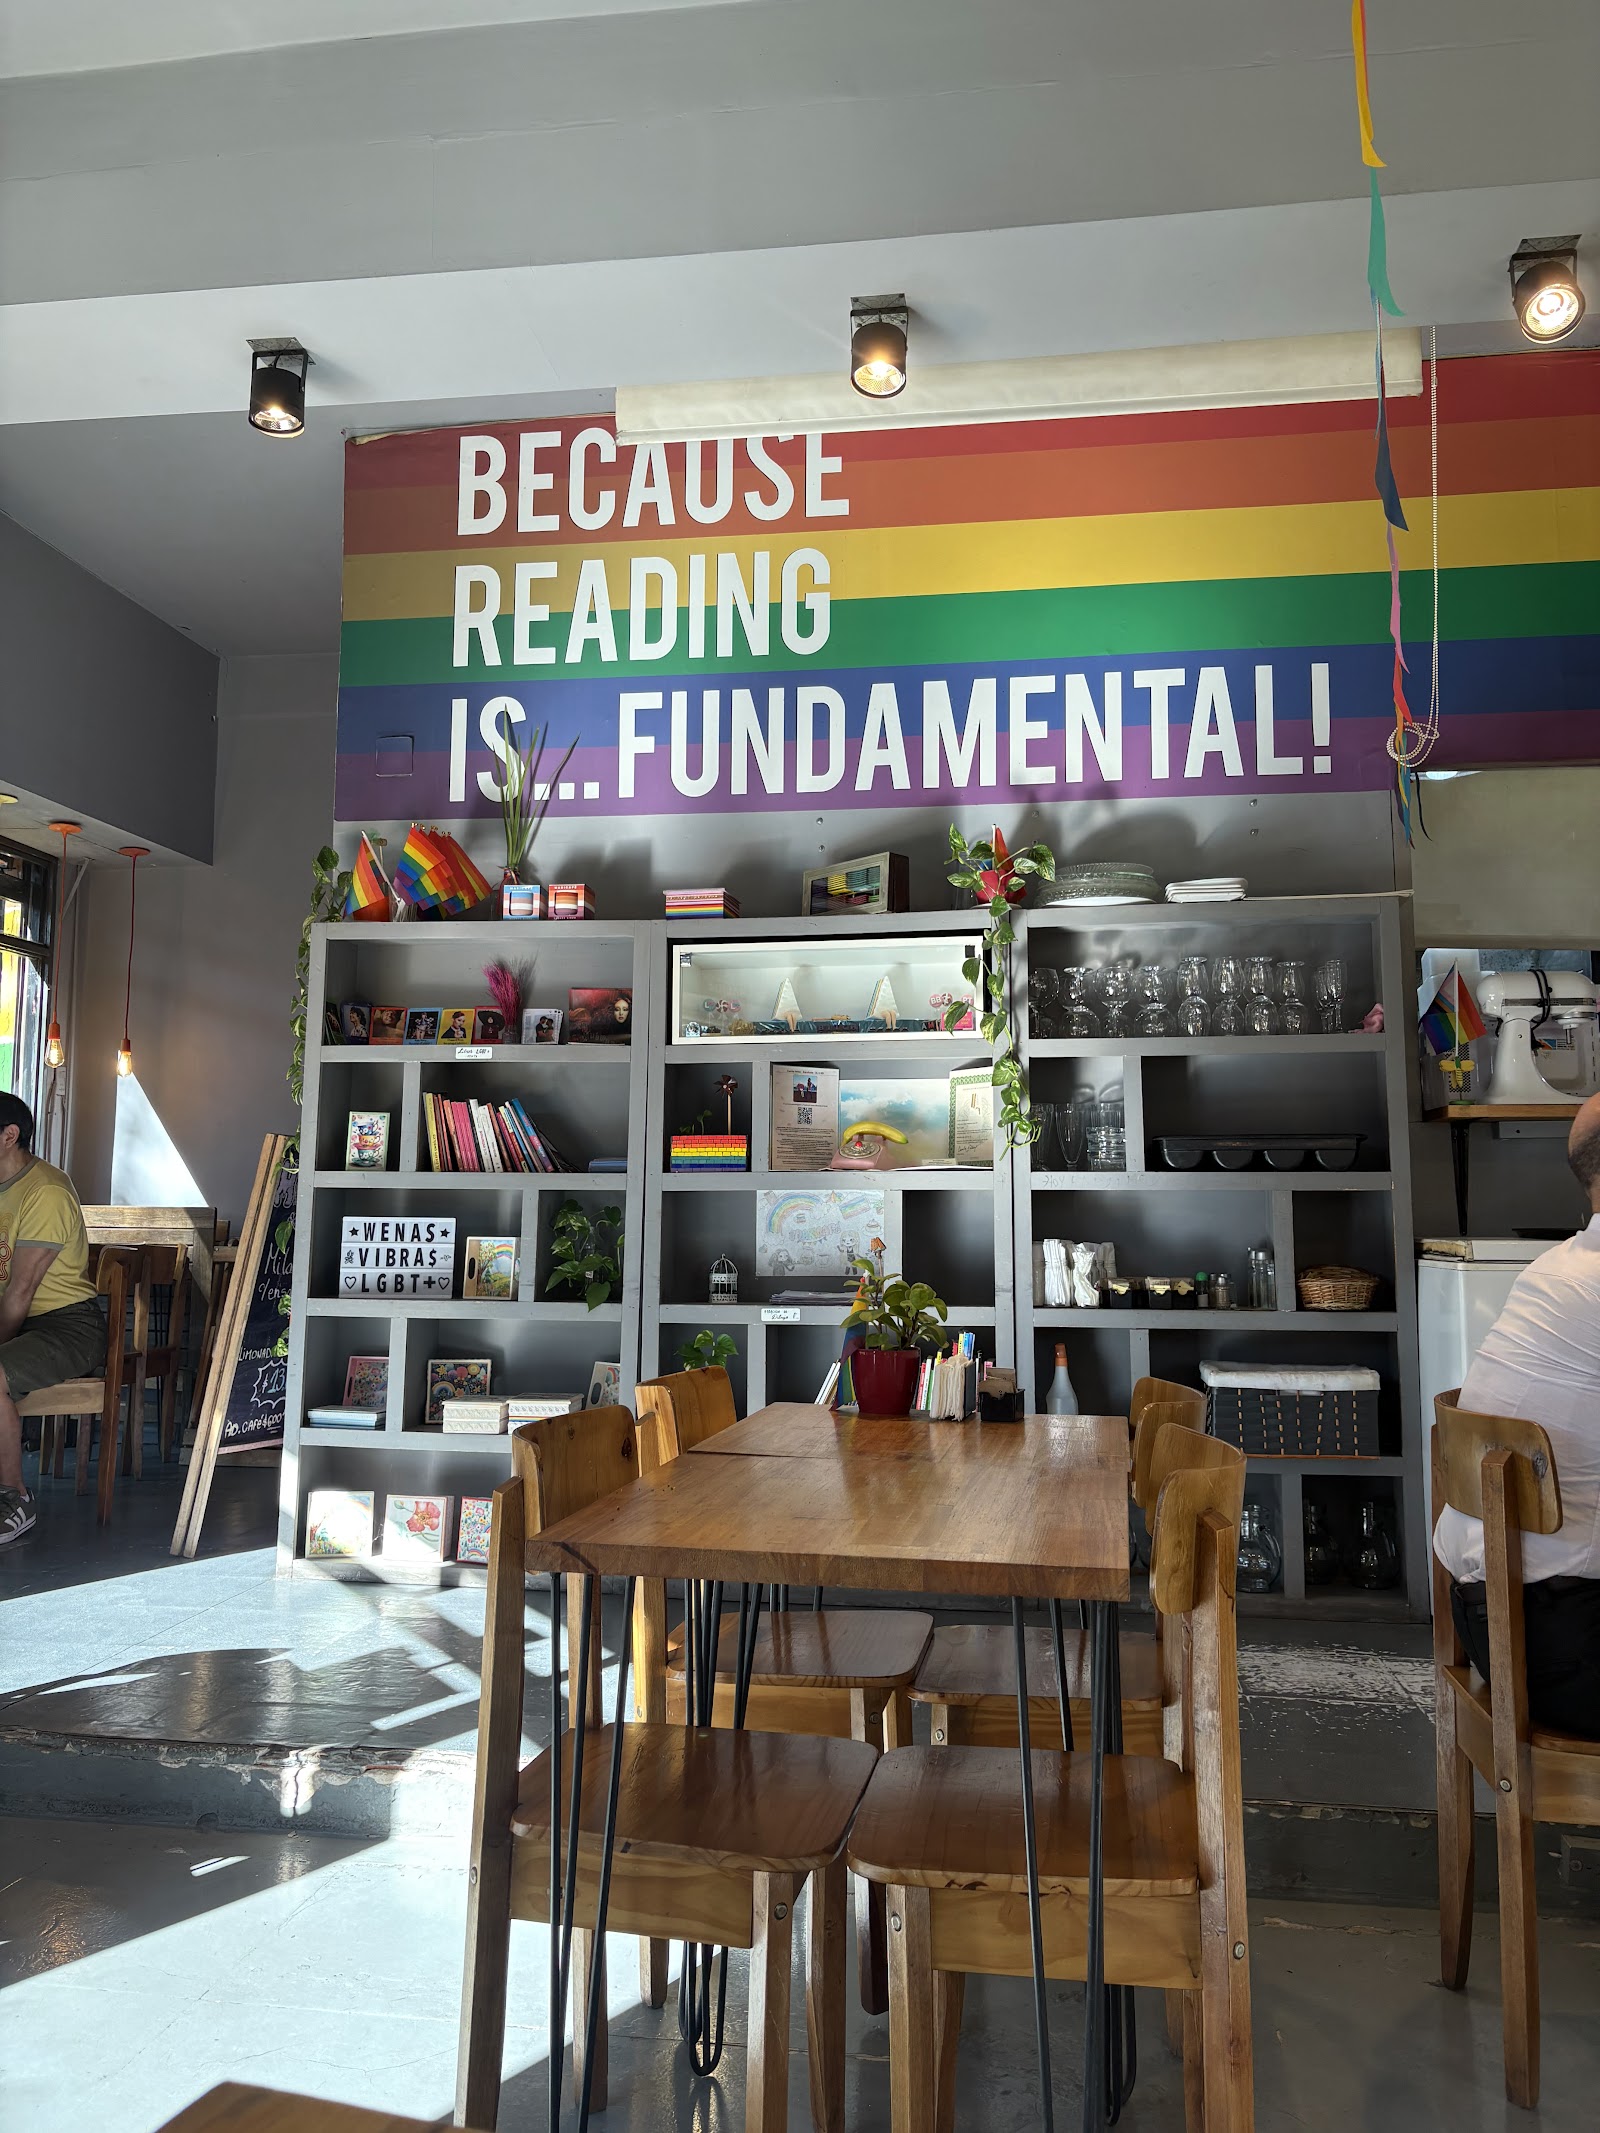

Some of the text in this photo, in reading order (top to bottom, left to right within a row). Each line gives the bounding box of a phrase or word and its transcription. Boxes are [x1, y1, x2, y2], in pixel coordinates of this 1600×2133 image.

[457, 427, 850, 536] BECAUSE
[453, 547, 831, 667] READING
[449, 662, 1332, 802] IS... FUNDAMENTAL!
[361, 1273, 436, 1293] LGBT+
[363, 1222, 436, 1243] WENAS
